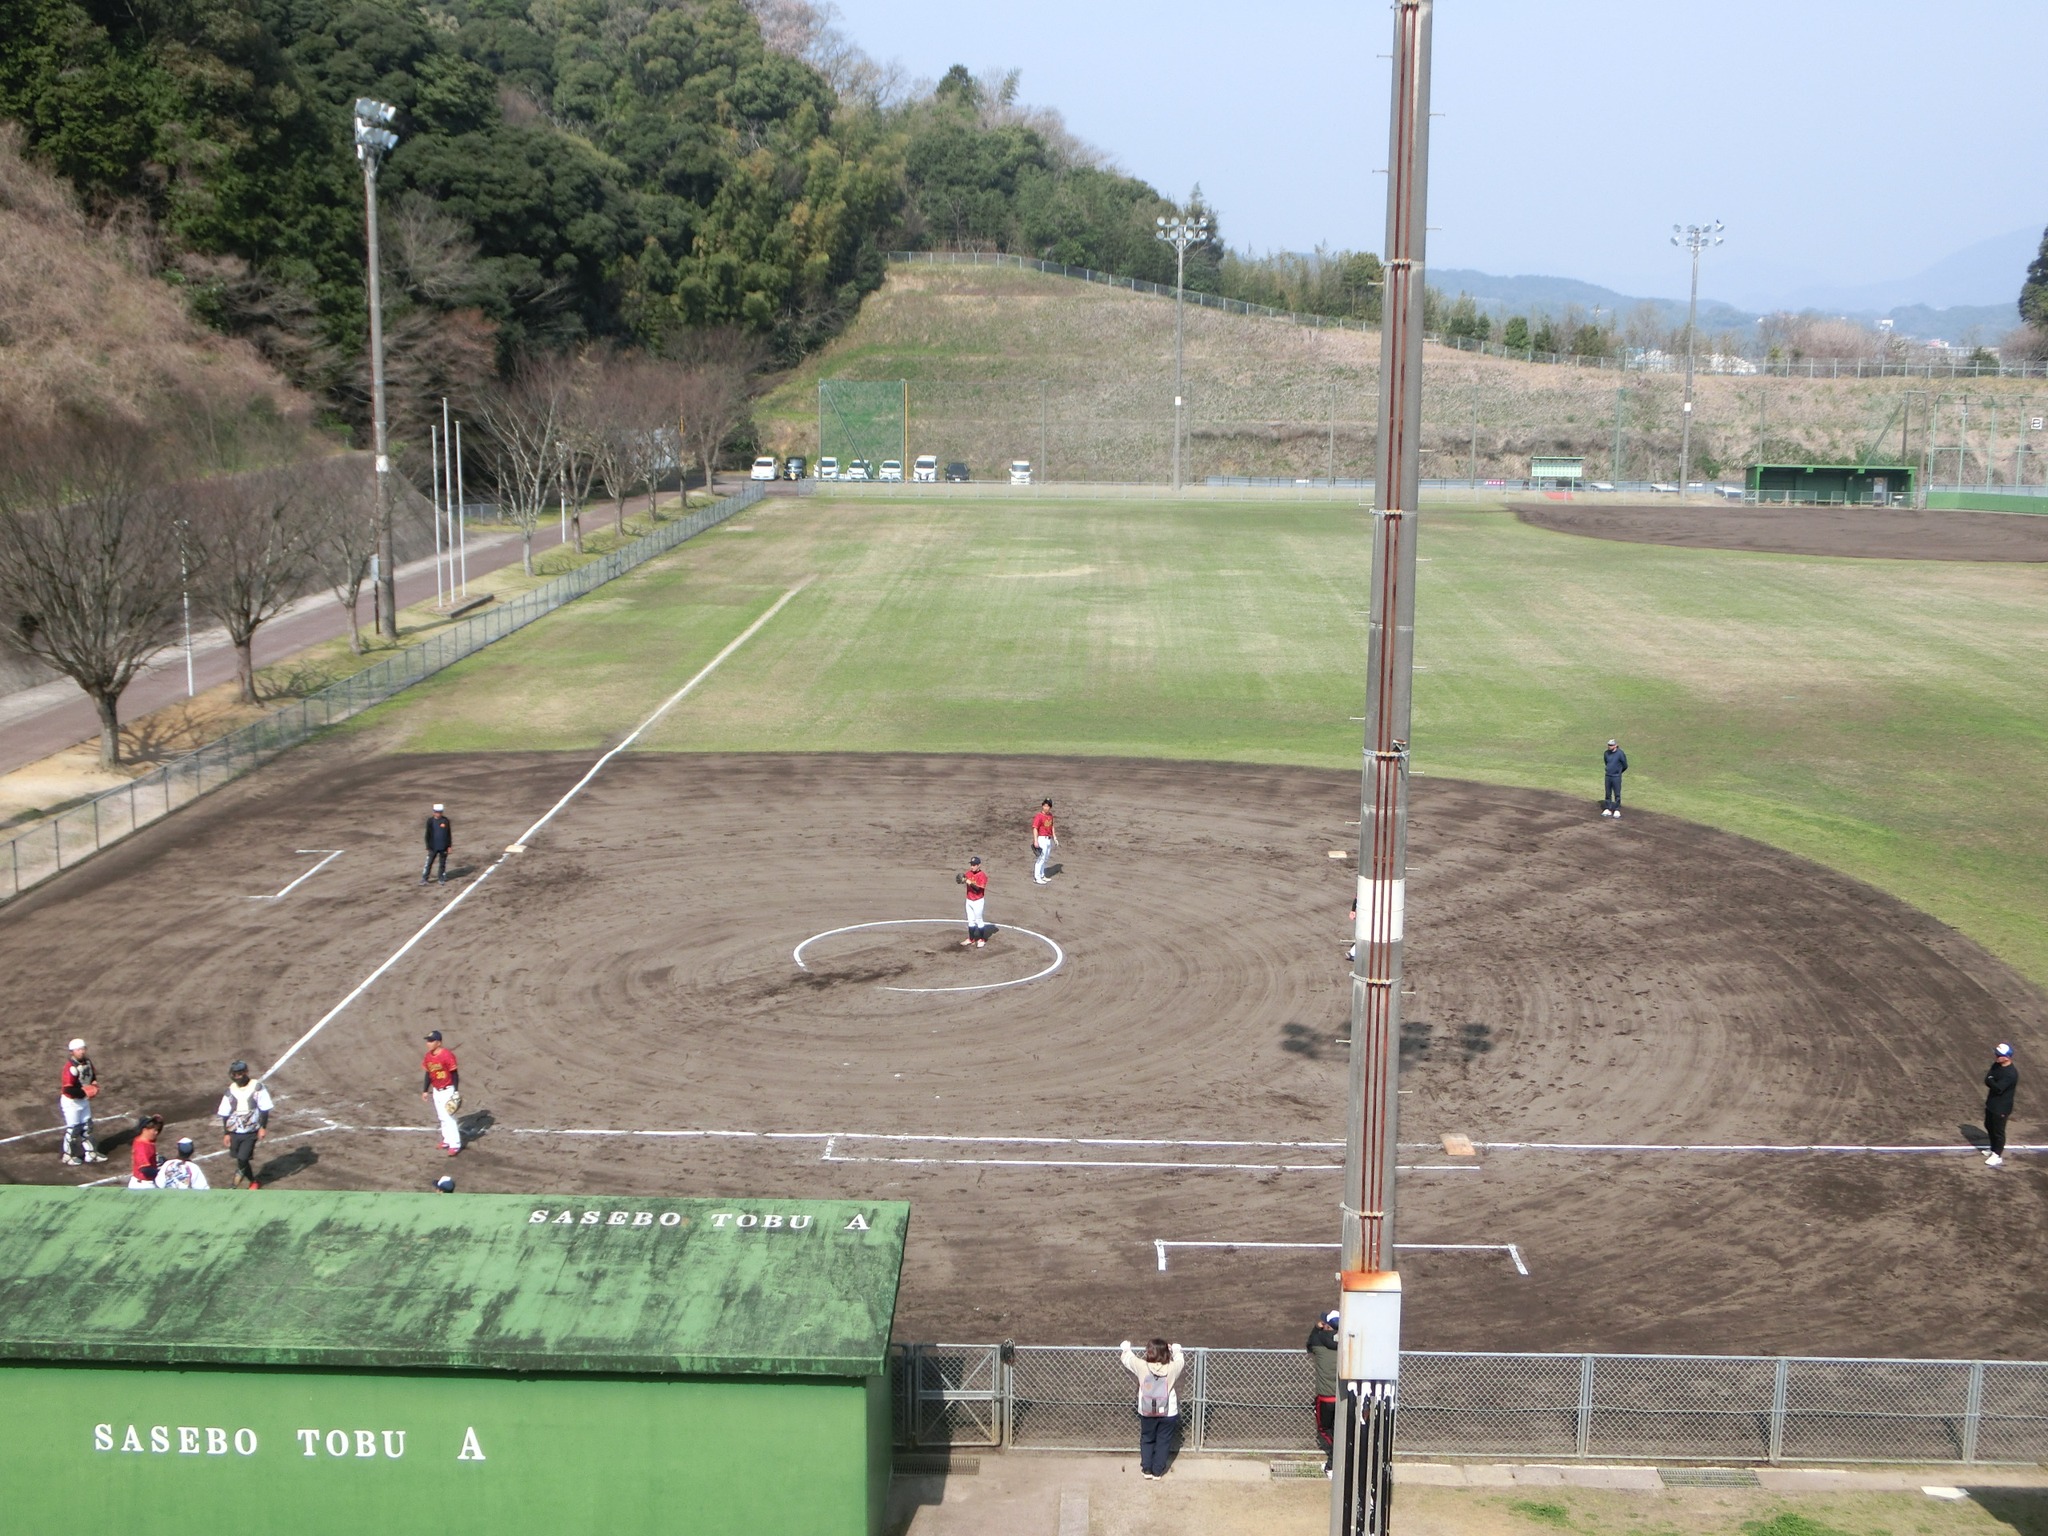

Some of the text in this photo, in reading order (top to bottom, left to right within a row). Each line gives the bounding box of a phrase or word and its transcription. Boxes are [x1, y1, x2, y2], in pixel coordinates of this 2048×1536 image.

[528, 1209, 871, 1231] SASEBO TOBU A
[94, 1423, 487, 1461] SASEBO TOBU A
